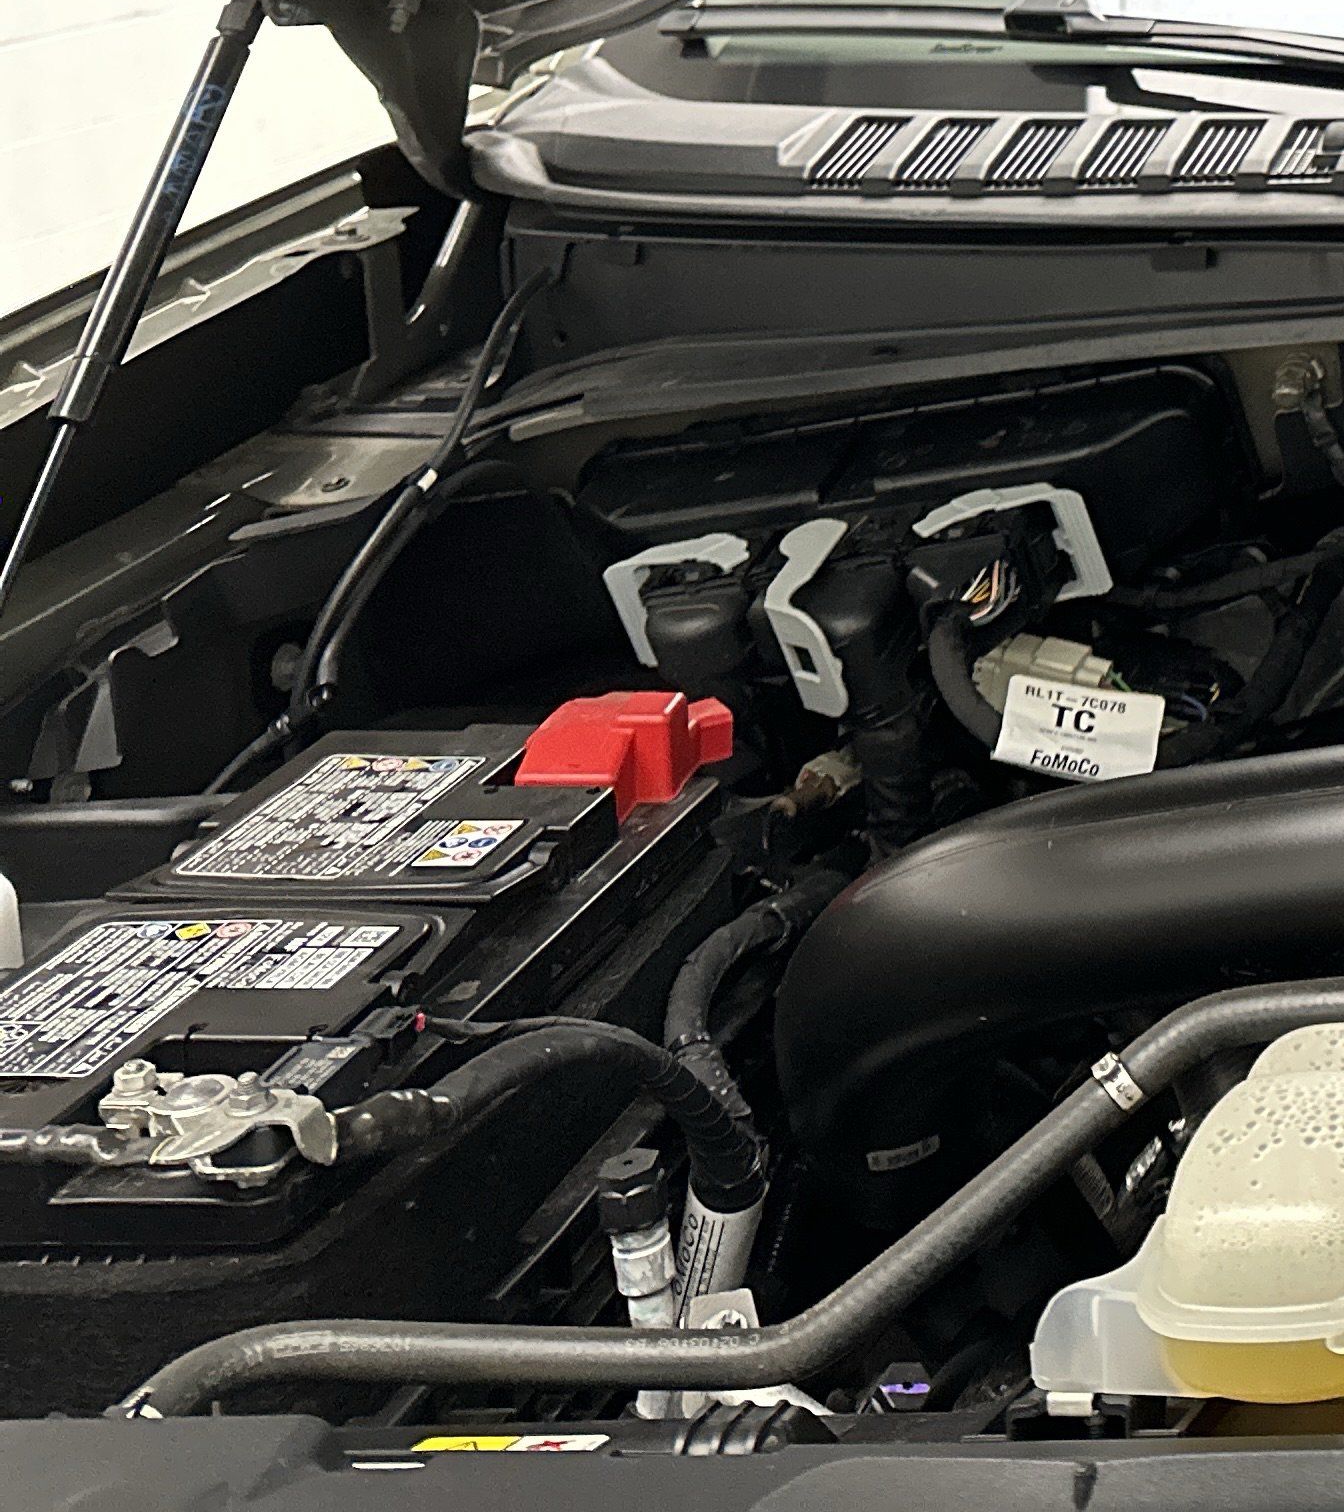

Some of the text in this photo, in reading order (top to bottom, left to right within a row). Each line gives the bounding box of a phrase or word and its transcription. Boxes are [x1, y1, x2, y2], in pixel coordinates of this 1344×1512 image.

[1051, 702, 1096, 734] TC
[1030, 748, 1100, 777] FoMoCo
[675, 1212, 698, 1296] oMoCo
